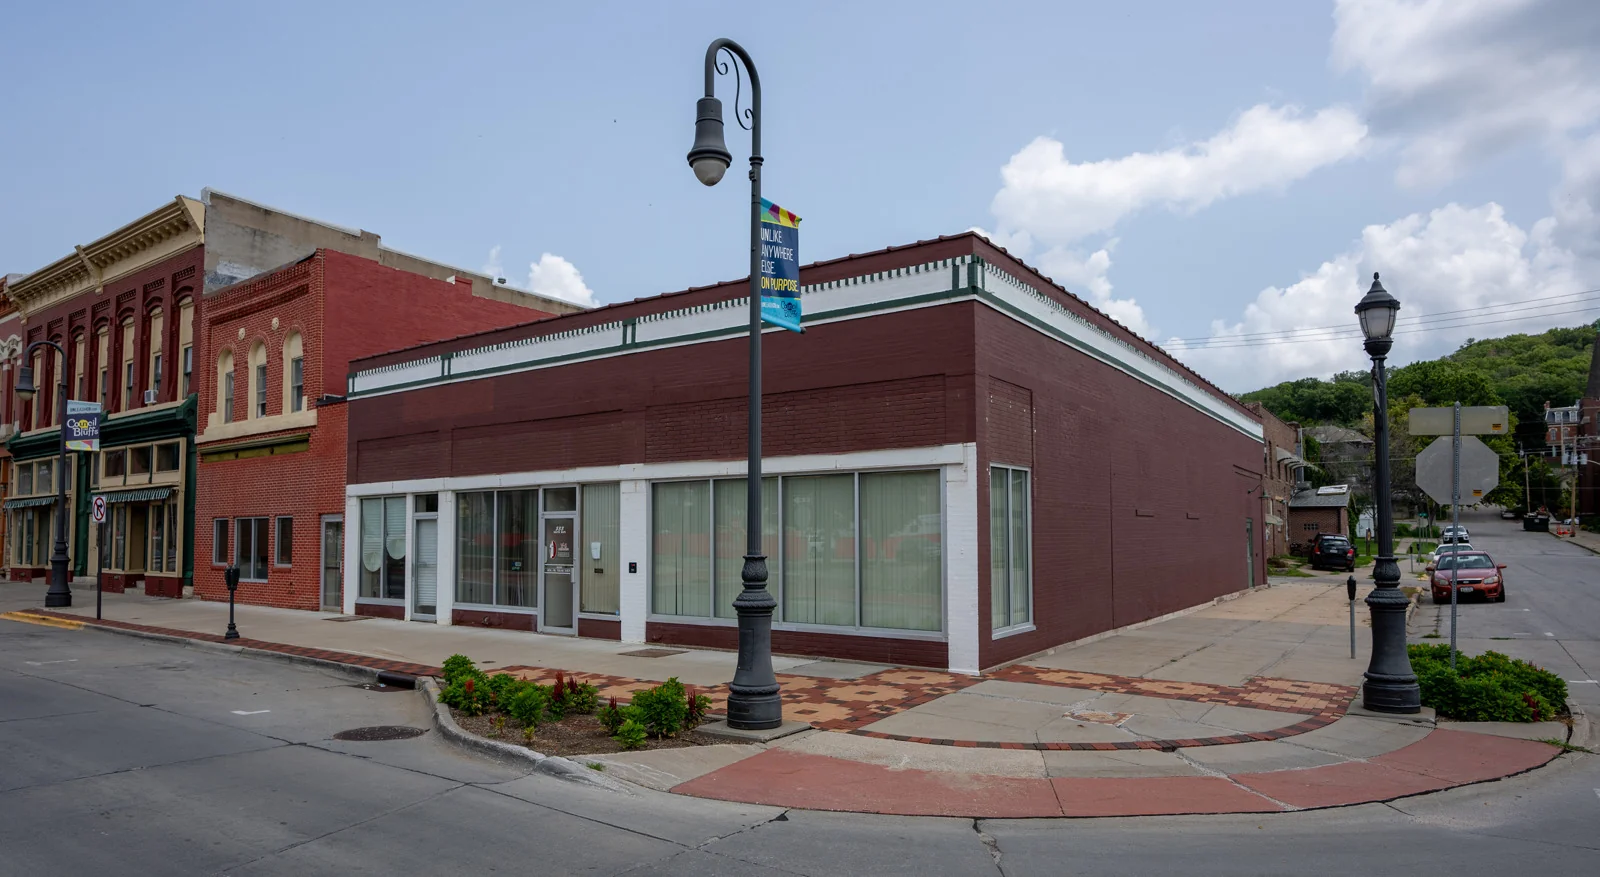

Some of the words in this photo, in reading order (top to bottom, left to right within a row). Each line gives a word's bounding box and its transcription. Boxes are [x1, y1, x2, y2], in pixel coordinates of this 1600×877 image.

[761, 227, 782, 243] UNLIKE
[761, 243, 793, 261] ANYWHERE
[761, 276, 770, 289] ON
[67, 417, 97, 429] Council
[72, 427, 99, 437] Bluffs
